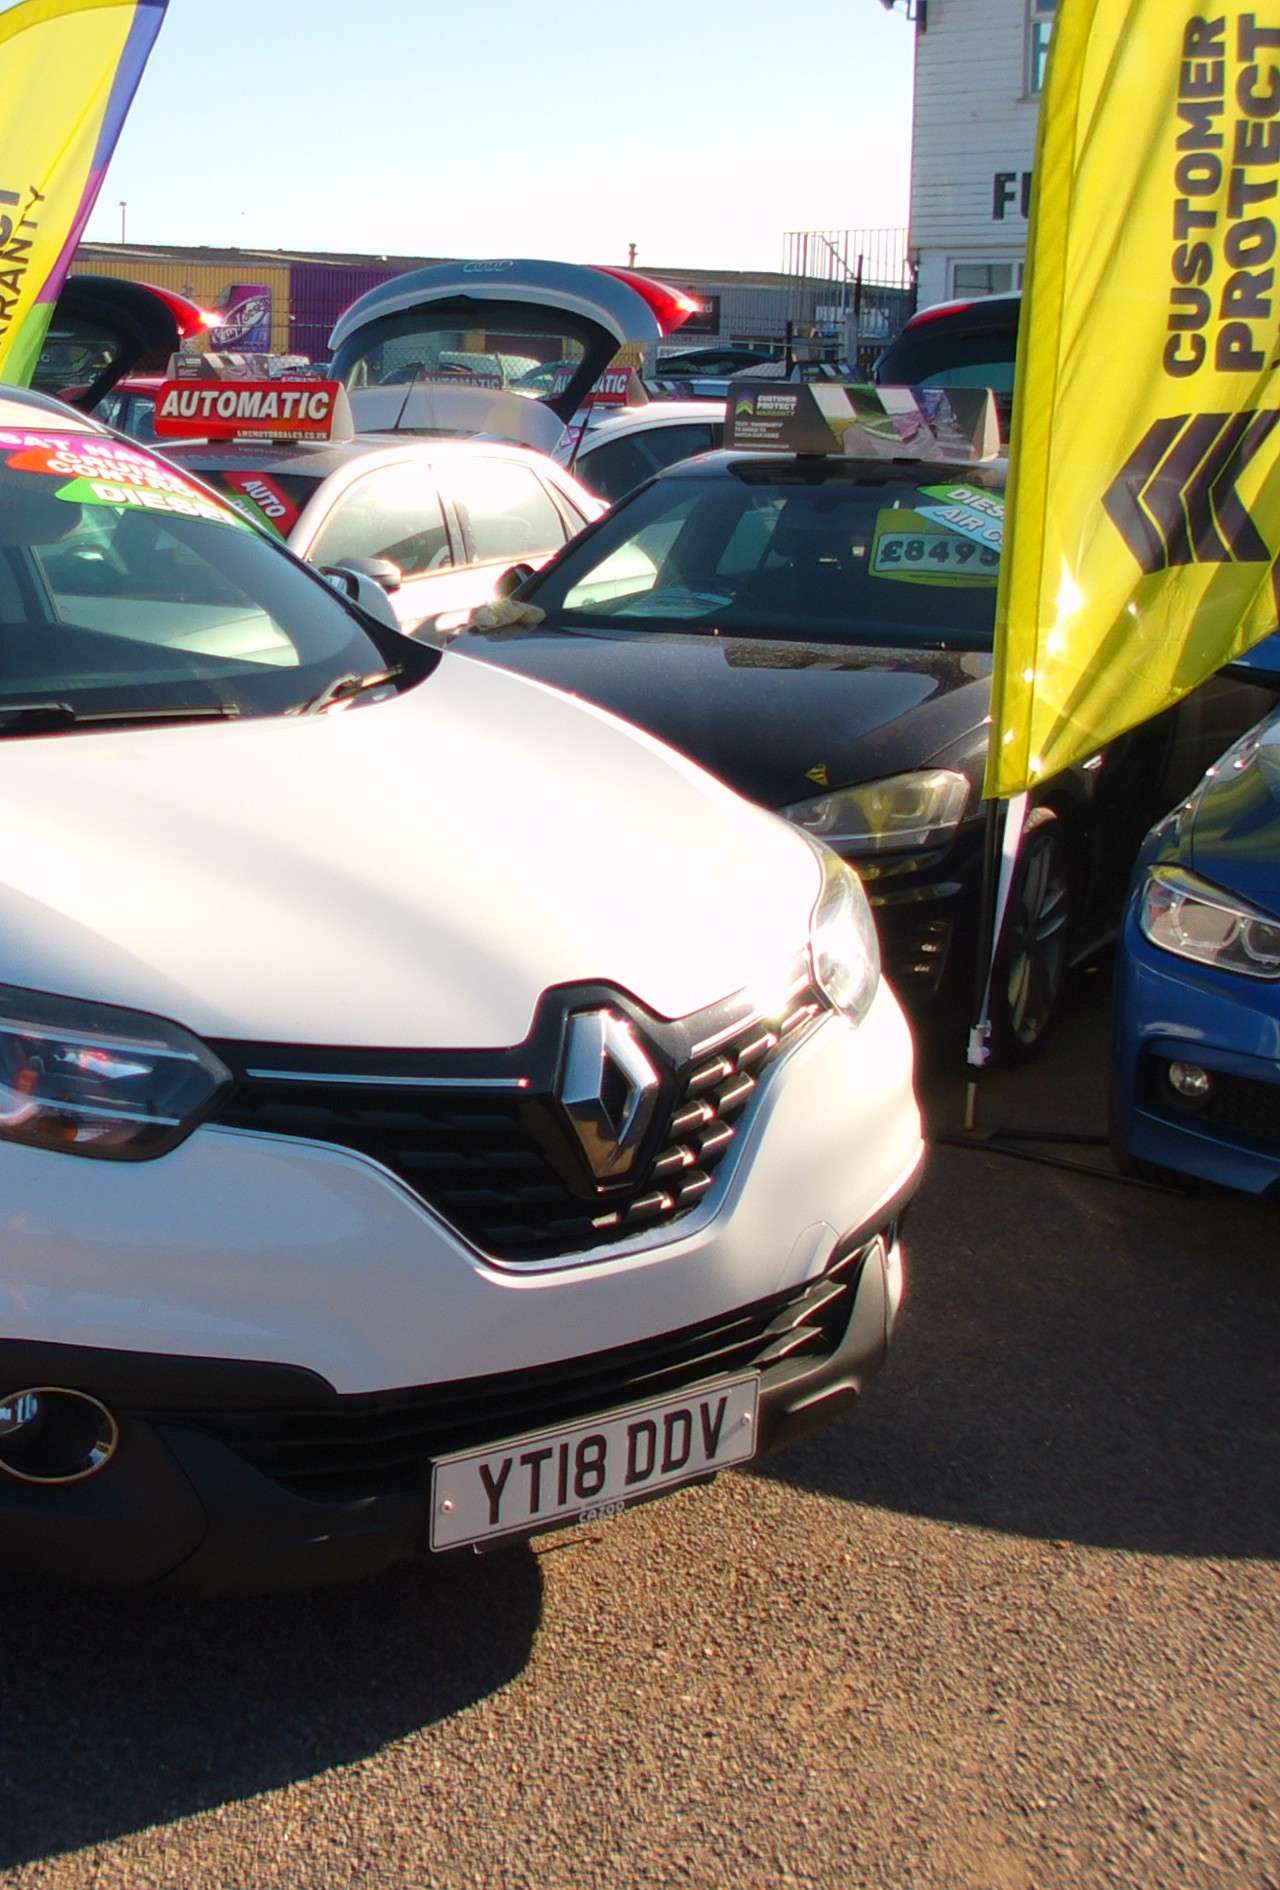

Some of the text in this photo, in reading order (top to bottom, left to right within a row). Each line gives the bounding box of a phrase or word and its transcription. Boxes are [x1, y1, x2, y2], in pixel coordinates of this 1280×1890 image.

[1162, 14, 1226, 378] CUSTOMER
[1214, 12, 1280, 373] PROTECT
[159, 389, 330, 420] AUTOMATIC
[240, 480, 286, 518] AUTO
[934, 508, 985, 533] AIR
[479, 1396, 728, 1525] YT18 DDV
